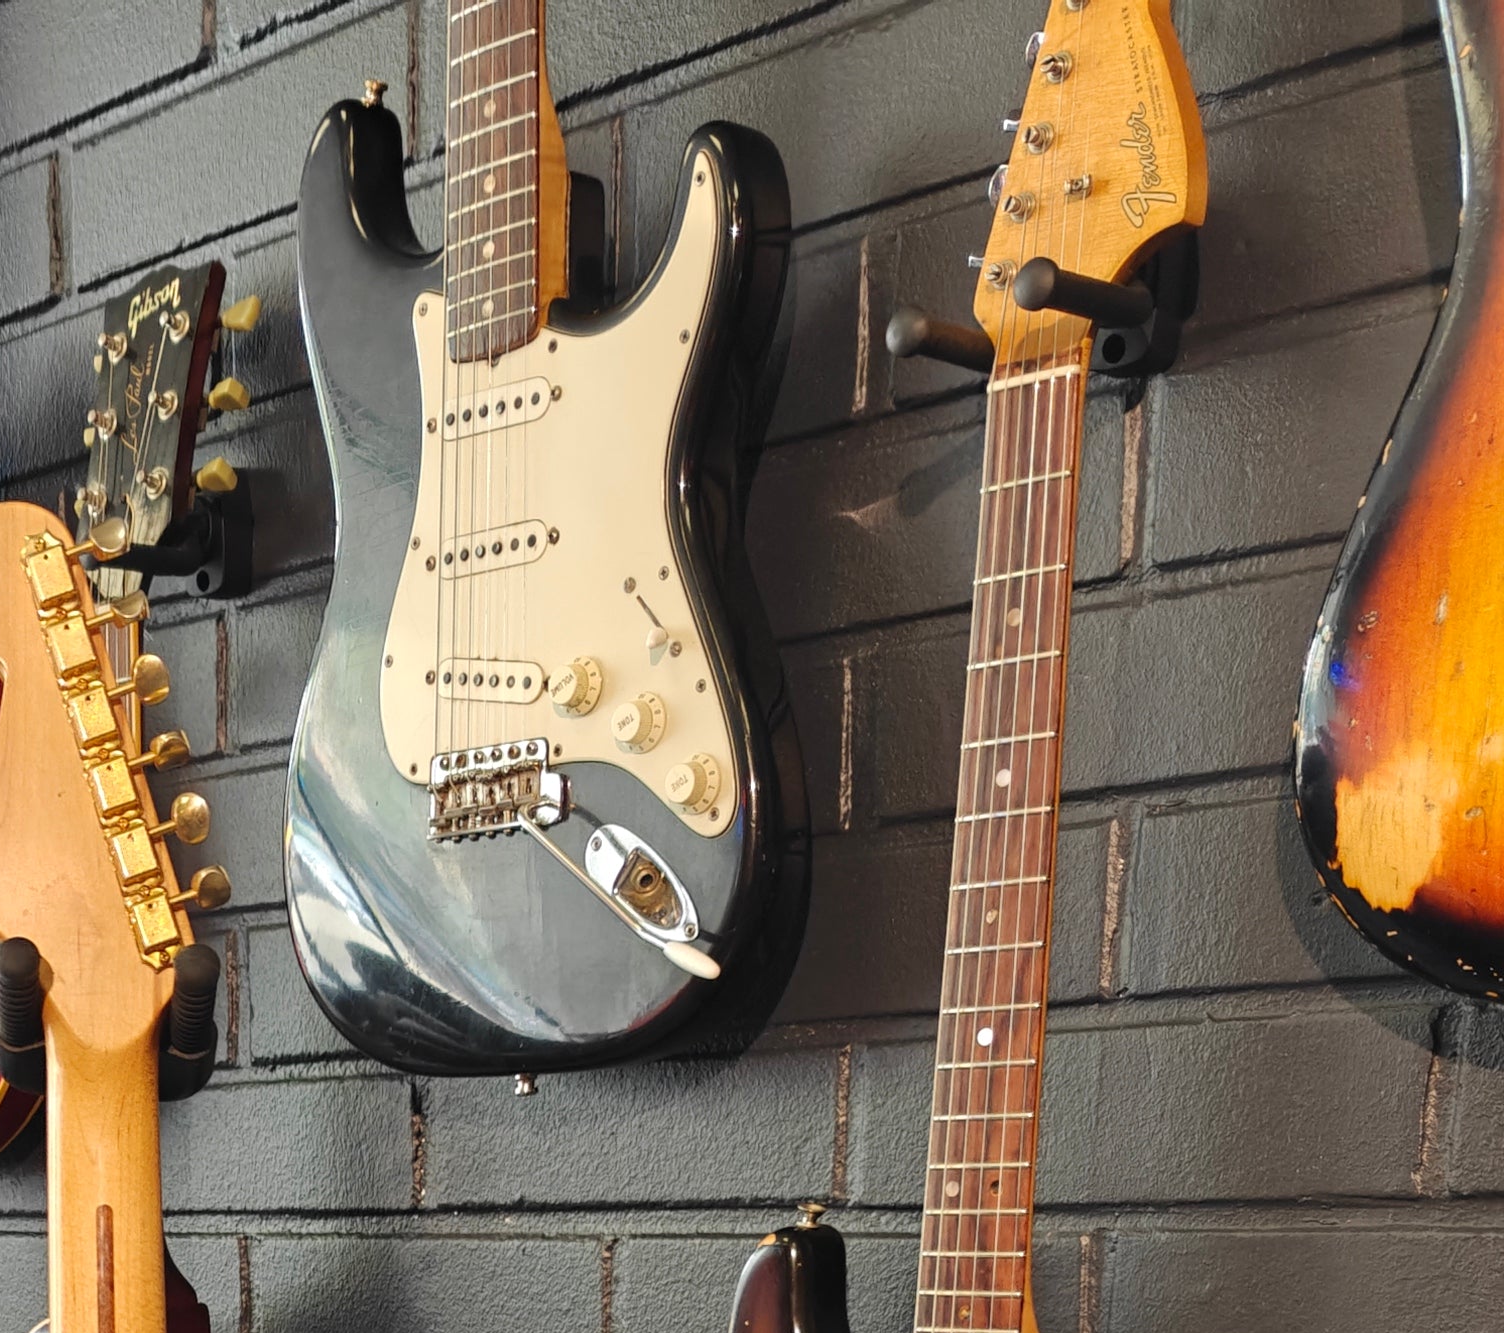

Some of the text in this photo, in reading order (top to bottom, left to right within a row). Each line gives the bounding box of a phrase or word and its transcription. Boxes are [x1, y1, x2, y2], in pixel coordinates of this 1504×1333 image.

[1120, 101, 1177, 229] Fender
[128, 277, 181, 340] Gibson
[121, 362, 145, 466] Les Paul
[550, 673, 575, 698] VOLUME
[617, 713, 634, 731] TONE
